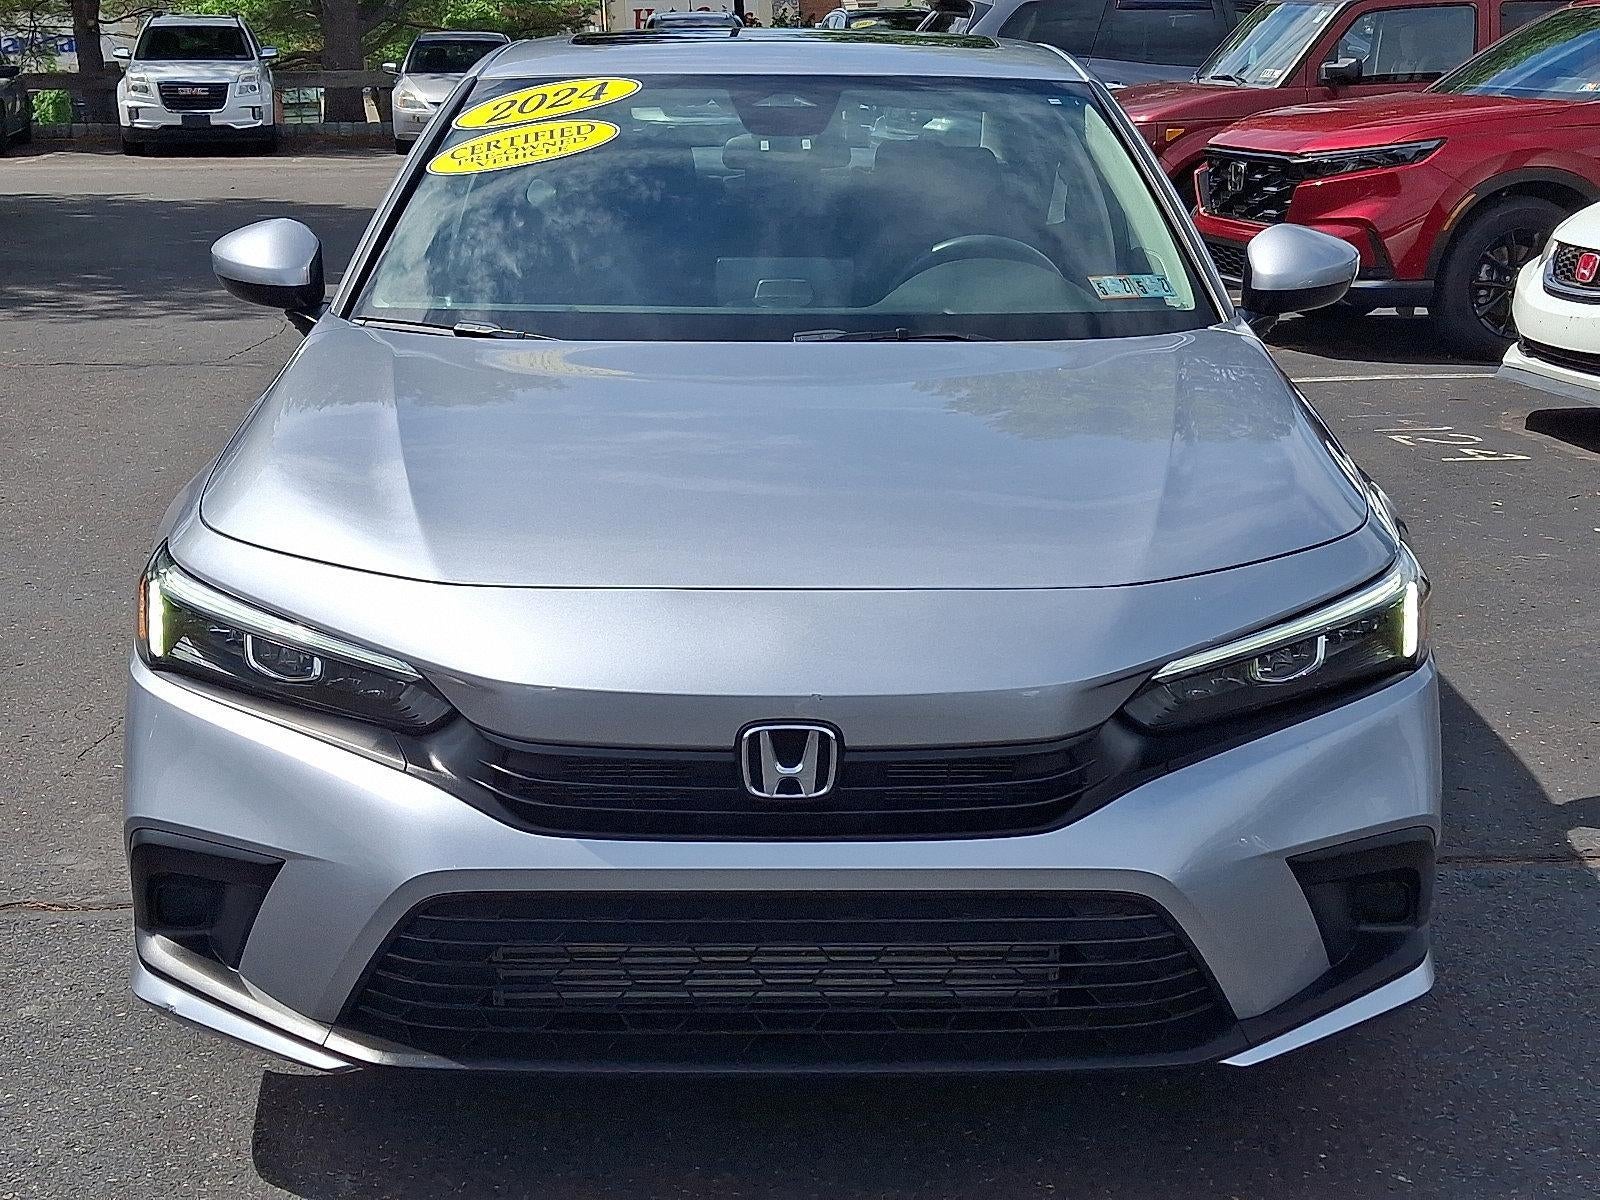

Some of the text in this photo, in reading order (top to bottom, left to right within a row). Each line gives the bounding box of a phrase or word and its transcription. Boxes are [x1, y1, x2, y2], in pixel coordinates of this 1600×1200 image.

[486, 82, 609, 123] 2024
[451, 124, 596, 160] CERTIFIED
[459, 137, 588, 166] PRE-OWNED
[474, 146, 569, 167] VEHICLE
